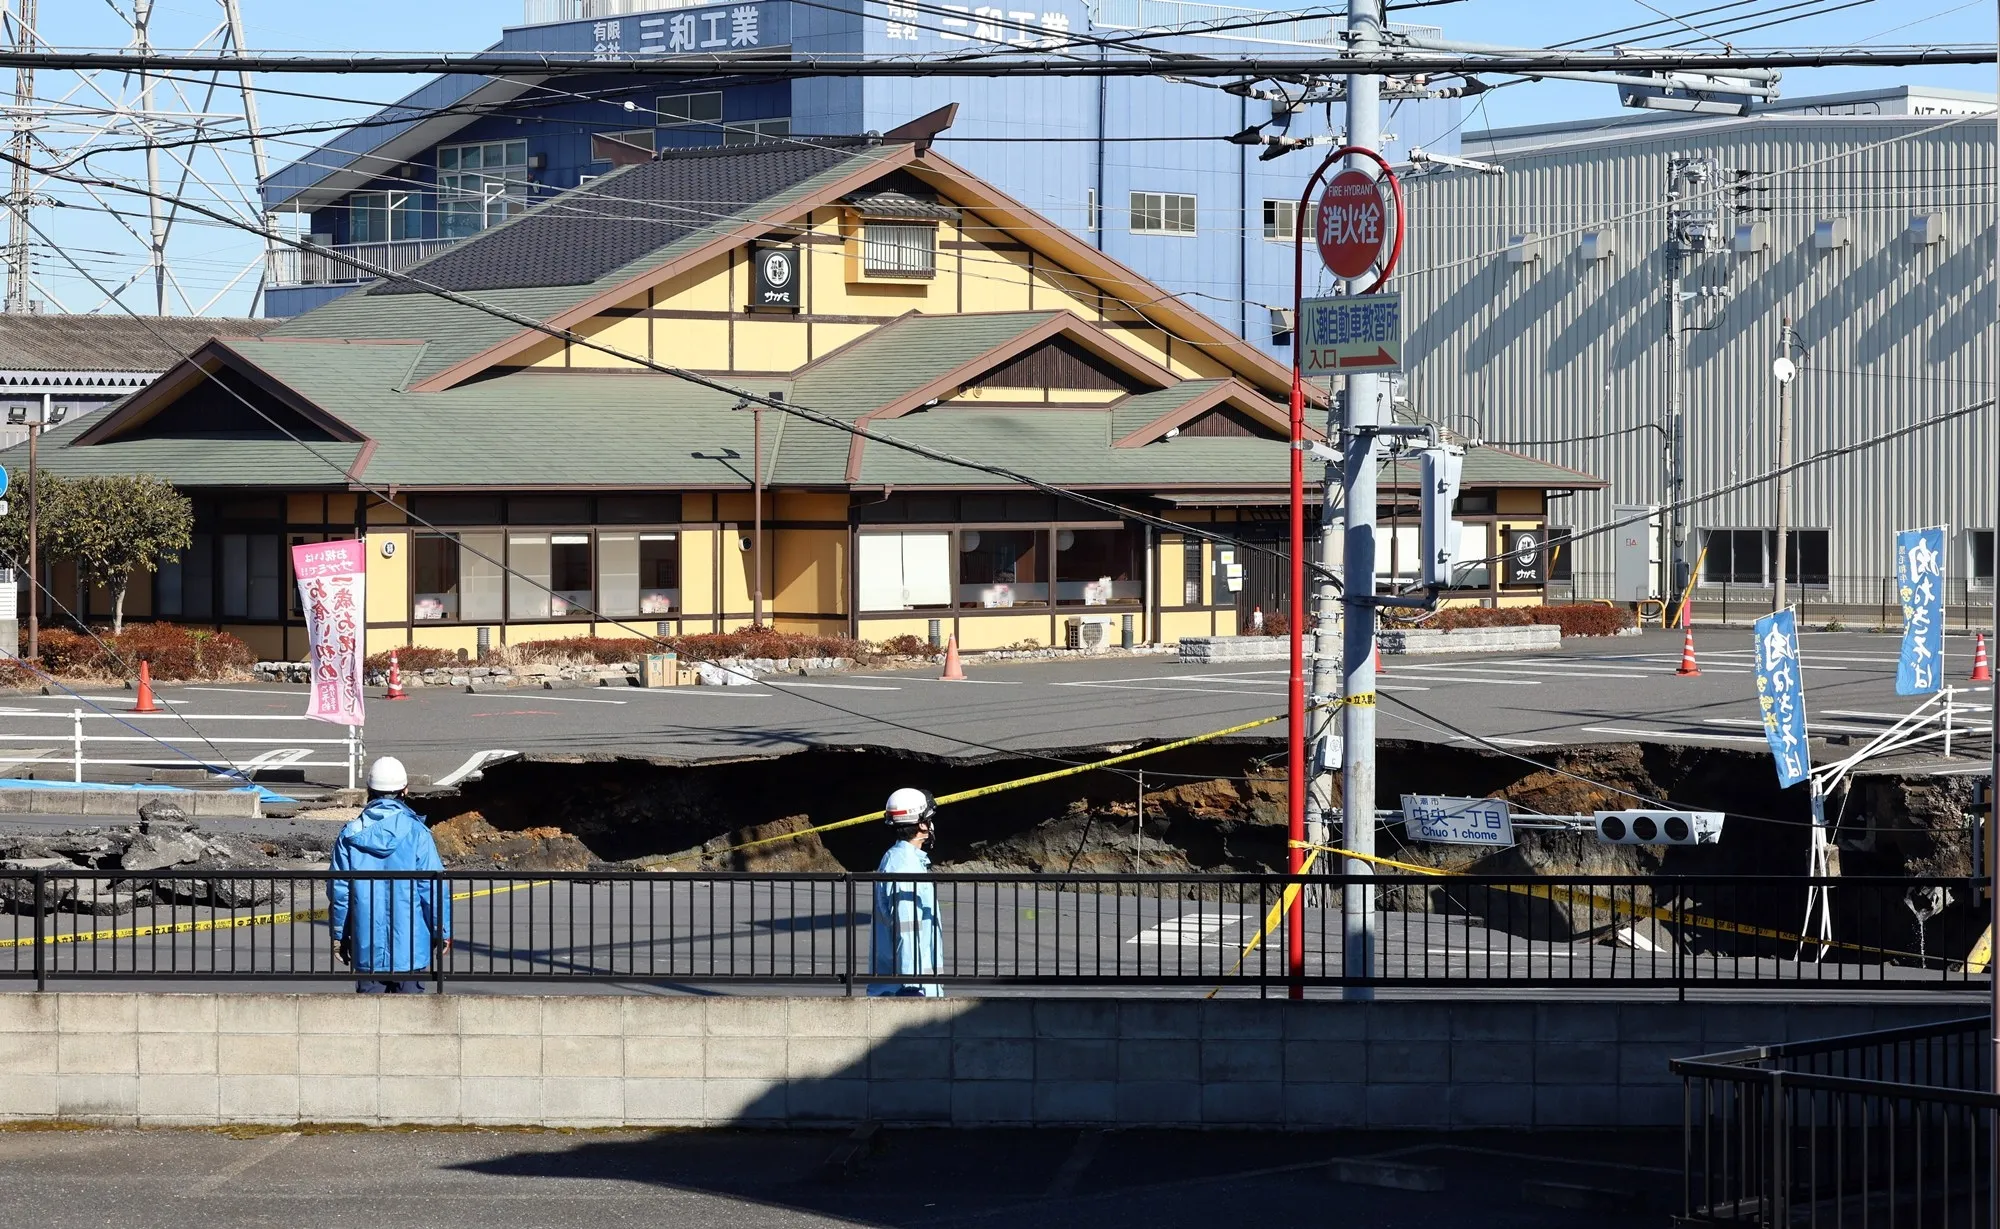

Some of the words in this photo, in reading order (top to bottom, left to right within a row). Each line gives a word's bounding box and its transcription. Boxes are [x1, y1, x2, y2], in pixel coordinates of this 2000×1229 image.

[593, 21, 621, 42] 有限
[640, 6, 759, 53] 三和工業
[940, 5, 1069, 53] 三和工業
[1328, 184, 1342, 197] FIRE
[1344, 183, 1374, 197] HYDRANT
[1322, 203, 1380, 245] 消火栓
[1305, 302, 1399, 346] 八潮自動車教習所
[1308, 349, 1337, 371] 入口
[1410, 797, 1439, 806] 八潮市
[1412, 806, 1501, 829] 中央一丁目
[1421, 826, 1448, 838] Chuo
[1453, 828, 1458, 838] 1
[1462, 829, 1497, 840] chome
